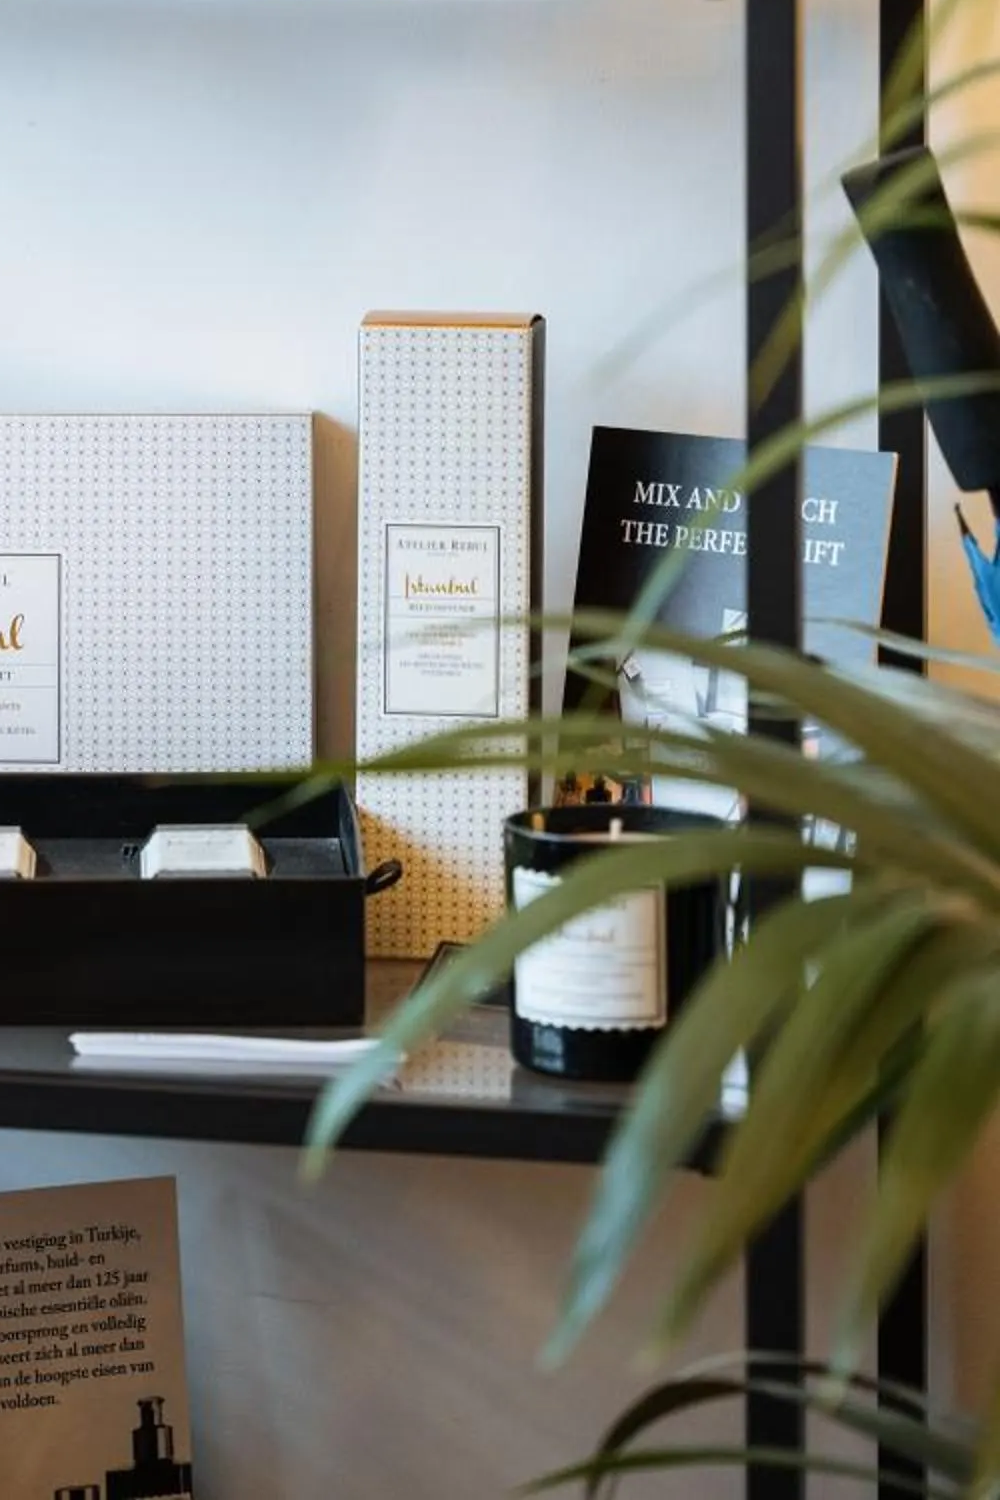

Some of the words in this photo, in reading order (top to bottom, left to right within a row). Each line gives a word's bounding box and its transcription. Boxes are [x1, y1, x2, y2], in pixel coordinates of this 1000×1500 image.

[634, 480, 683, 507] MIX
[686, 486, 742, 513] AND
[621, 519, 669, 547] THE
[674, 525, 748, 555] PERFE
[803, 539, 846, 566] IFT
[4, 1231, 66, 1253] vestiging
[69, 1229, 83, 1245] in
[47, 1250, 84, 1269] huid-
[88, 1252, 105, 1265] en
[13, 1278, 24, 1295] al
[29, 1279, 62, 1294] meer
[66, 1273, 91, 1290] dan
[95, 1270, 120, 1287] 125
[122, 1269, 148, 1290] jaar
[71, 1321, 88, 1334] en
[91, 1312, 146, 1333] volledig
[34, 1342, 63, 1361] zich
[66, 1340, 78, 1358] al
[82, 1341, 116, 1356] meer
[119, 1335, 145, 1352] dan
[15, 1370, 31, 1387] de
[35, 1366, 88, 1387] hoogste
[92, 1361, 126, 1378] eisen
[130, 1360, 154, 1374] van
